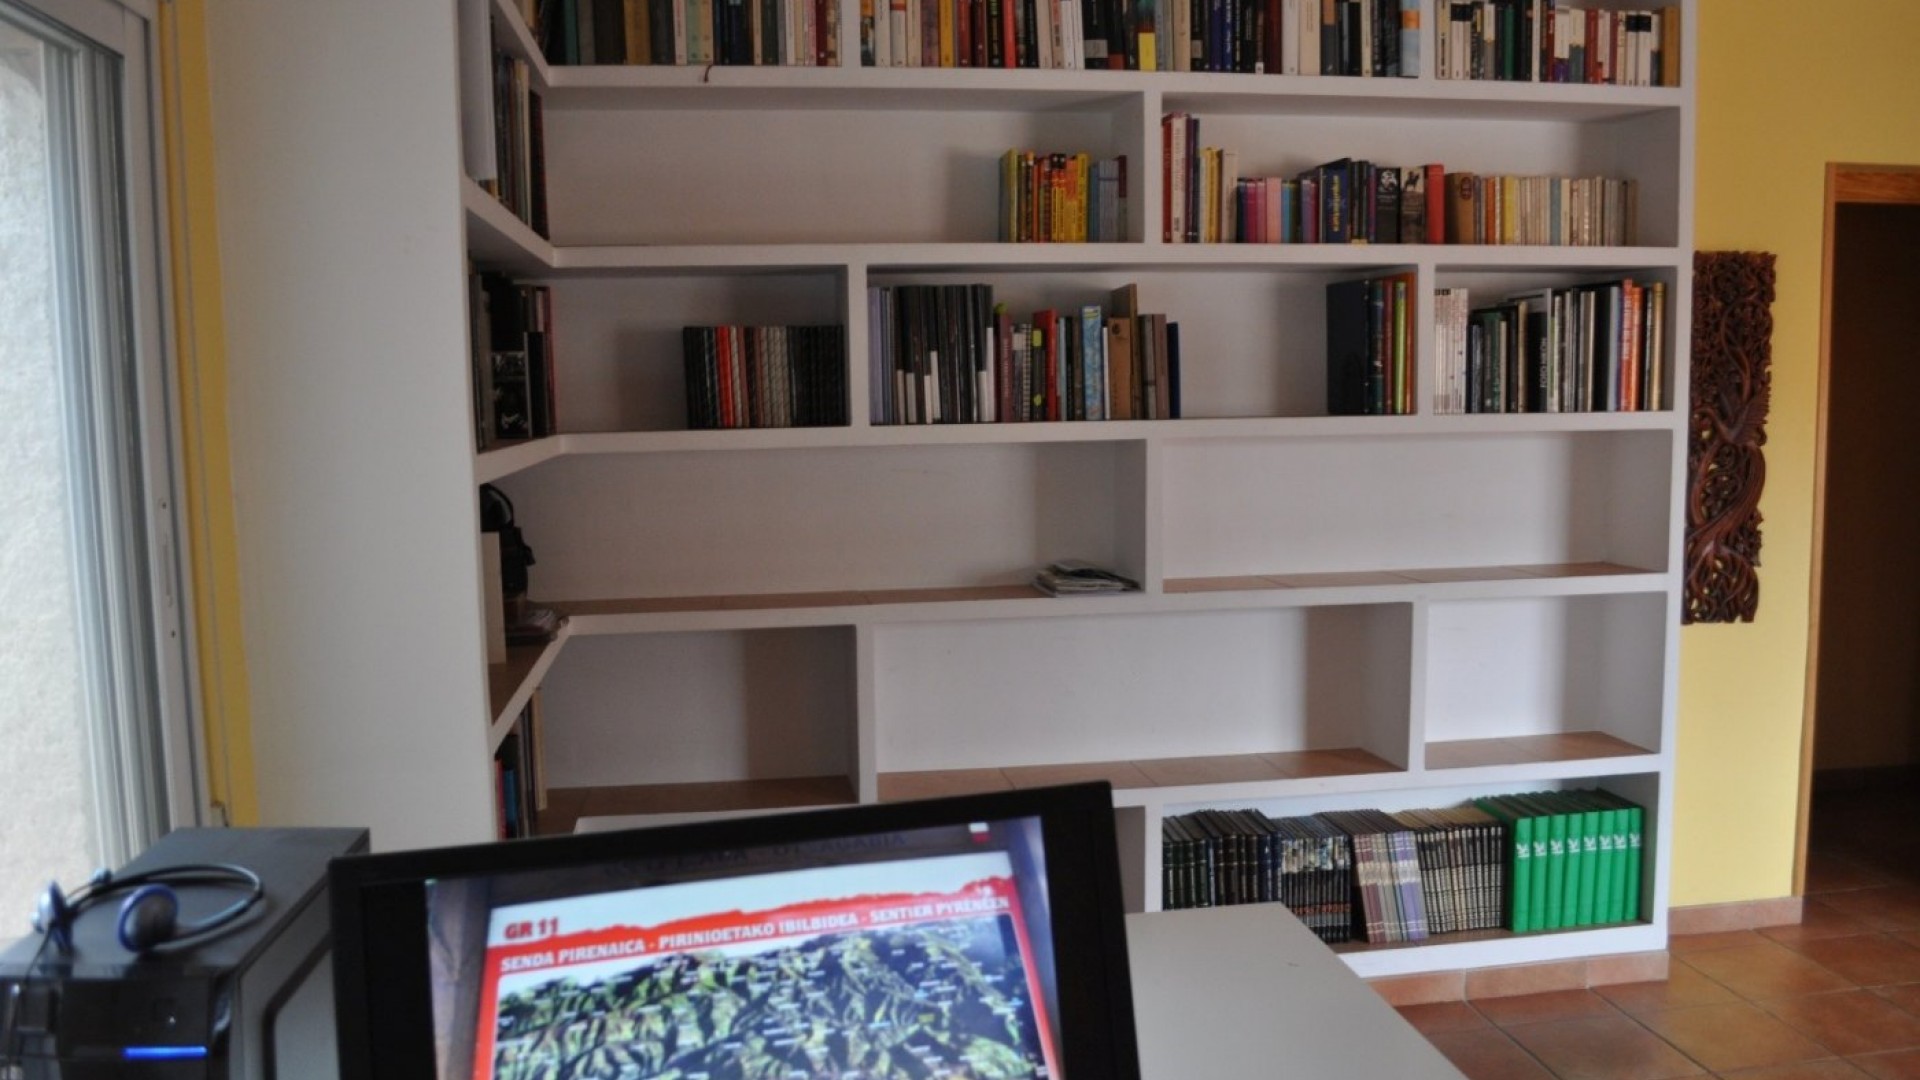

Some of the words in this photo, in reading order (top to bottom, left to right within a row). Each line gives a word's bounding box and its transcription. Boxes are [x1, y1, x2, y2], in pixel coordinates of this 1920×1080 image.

[500, 952, 554, 972] SENDA
[558, 940, 644, 964] PIRENAICA
[659, 923, 774, 949] PIRINIOETAKO
[779, 912, 857, 934] IBILBIDEA
[870, 905, 932, 923] SENTIER
[504, 921, 533, 940] GR
[538, 917, 559, 935] 11
